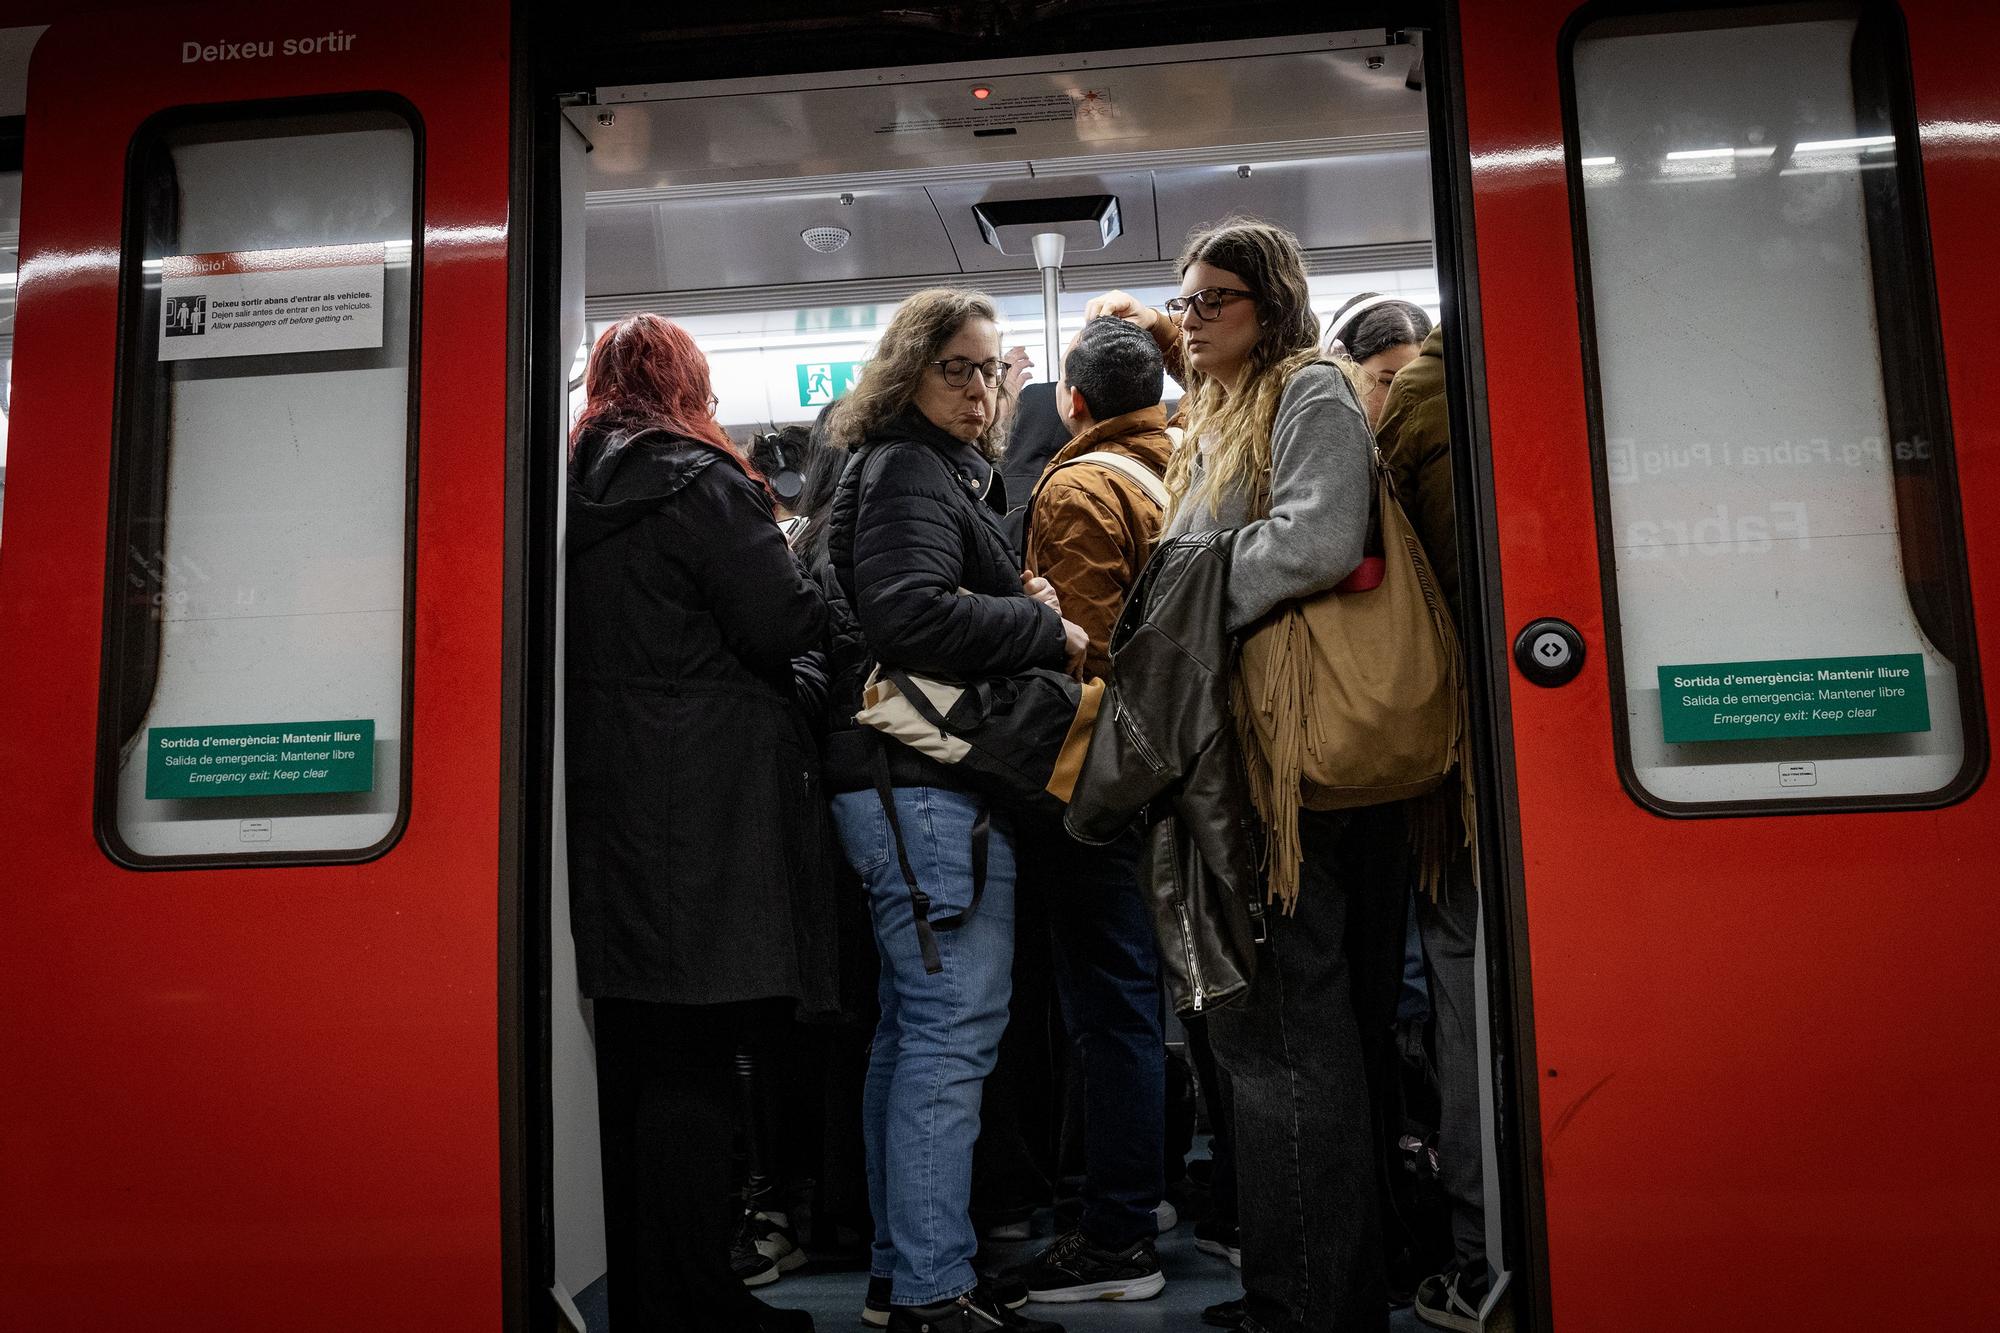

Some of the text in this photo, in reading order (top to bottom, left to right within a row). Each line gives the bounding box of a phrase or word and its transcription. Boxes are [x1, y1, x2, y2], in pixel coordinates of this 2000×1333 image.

[182, 30, 357, 63] Deixeu sortir
[212, 300, 239, 308] Deixeu
[241, 298, 263, 306] sortir
[212, 311, 233, 320] Dejen
[235, 310, 250, 318] salir
[286, 305, 308, 314] entrar
[211, 322, 232, 330] Allow
[233, 320, 277, 330] passengers
[290, 316, 313, 325] before
[315, 315, 340, 324] getting
[1674, 667, 1910, 688] Sortida d'emergència: Mantenir lliure
[1682, 687, 1905, 707] Salida de emergencia: Mantener libre
[1713, 708, 1877, 725] Emergency exit: Keep clear
[160, 732, 361, 749] Sortida d'emergència: Mantenir lliure
[165, 750, 355, 766] Salida de emergencia: Mantener libre
[189, 768, 328, 784] Emergency exit: Keep clear
